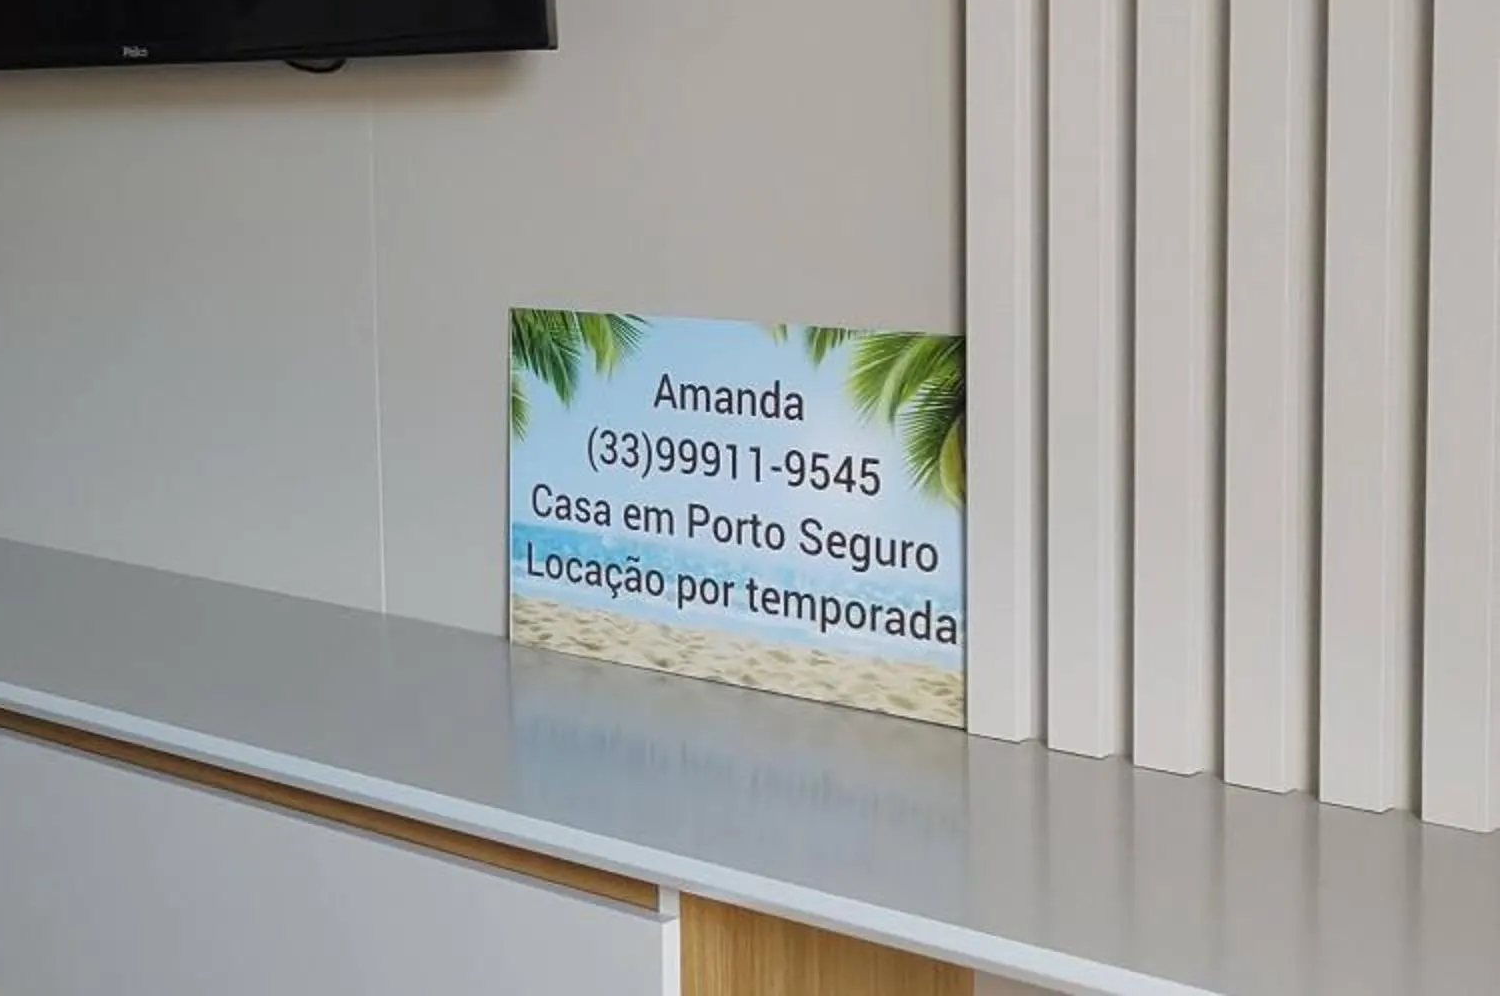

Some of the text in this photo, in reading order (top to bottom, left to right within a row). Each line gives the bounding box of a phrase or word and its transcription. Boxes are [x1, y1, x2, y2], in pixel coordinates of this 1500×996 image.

[653, 373, 805, 420] Amanda
[586, 426, 882, 496] (33)99911-9545
[531, 484, 939, 572] Casa em Porto Seguro
[526, 541, 958, 645] Locação por temporada
